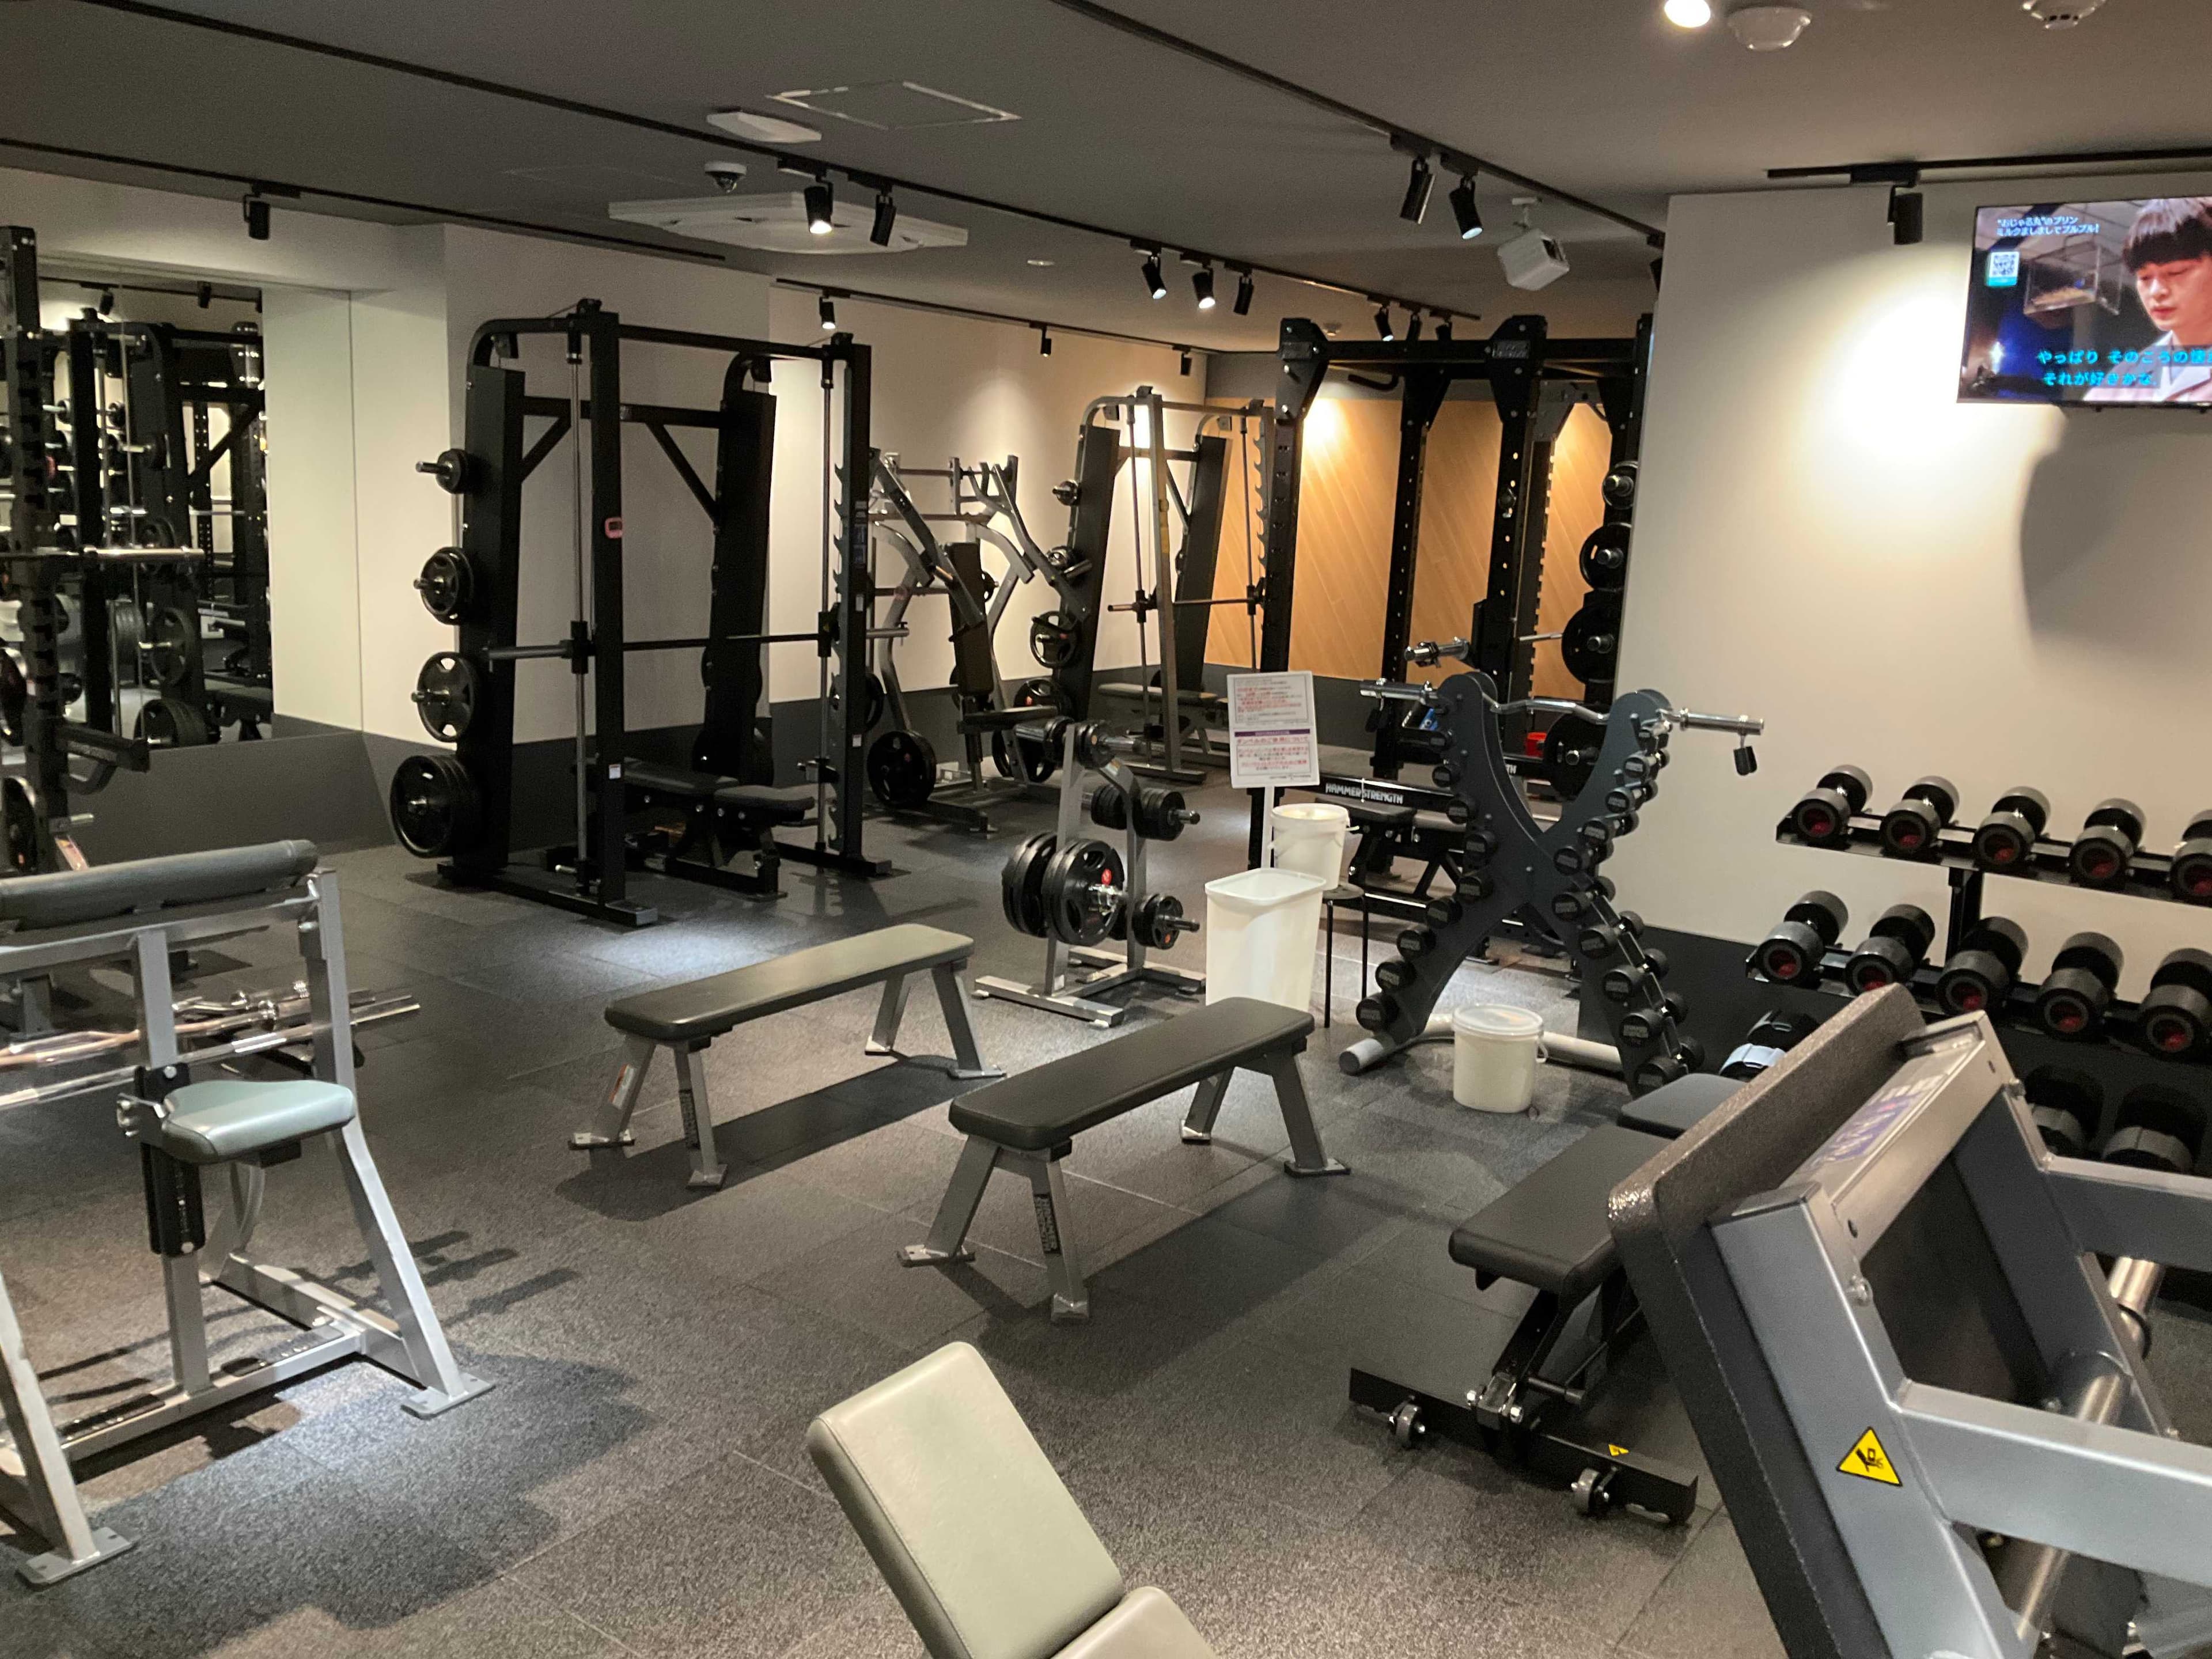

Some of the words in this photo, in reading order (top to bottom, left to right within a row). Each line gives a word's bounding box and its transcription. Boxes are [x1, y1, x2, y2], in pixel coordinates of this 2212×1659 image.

[2037, 349, 2099, 364] やっぱり
[1325, 783, 1362, 797] HAMMER
[1362, 789, 1403, 804] STRENGTH
